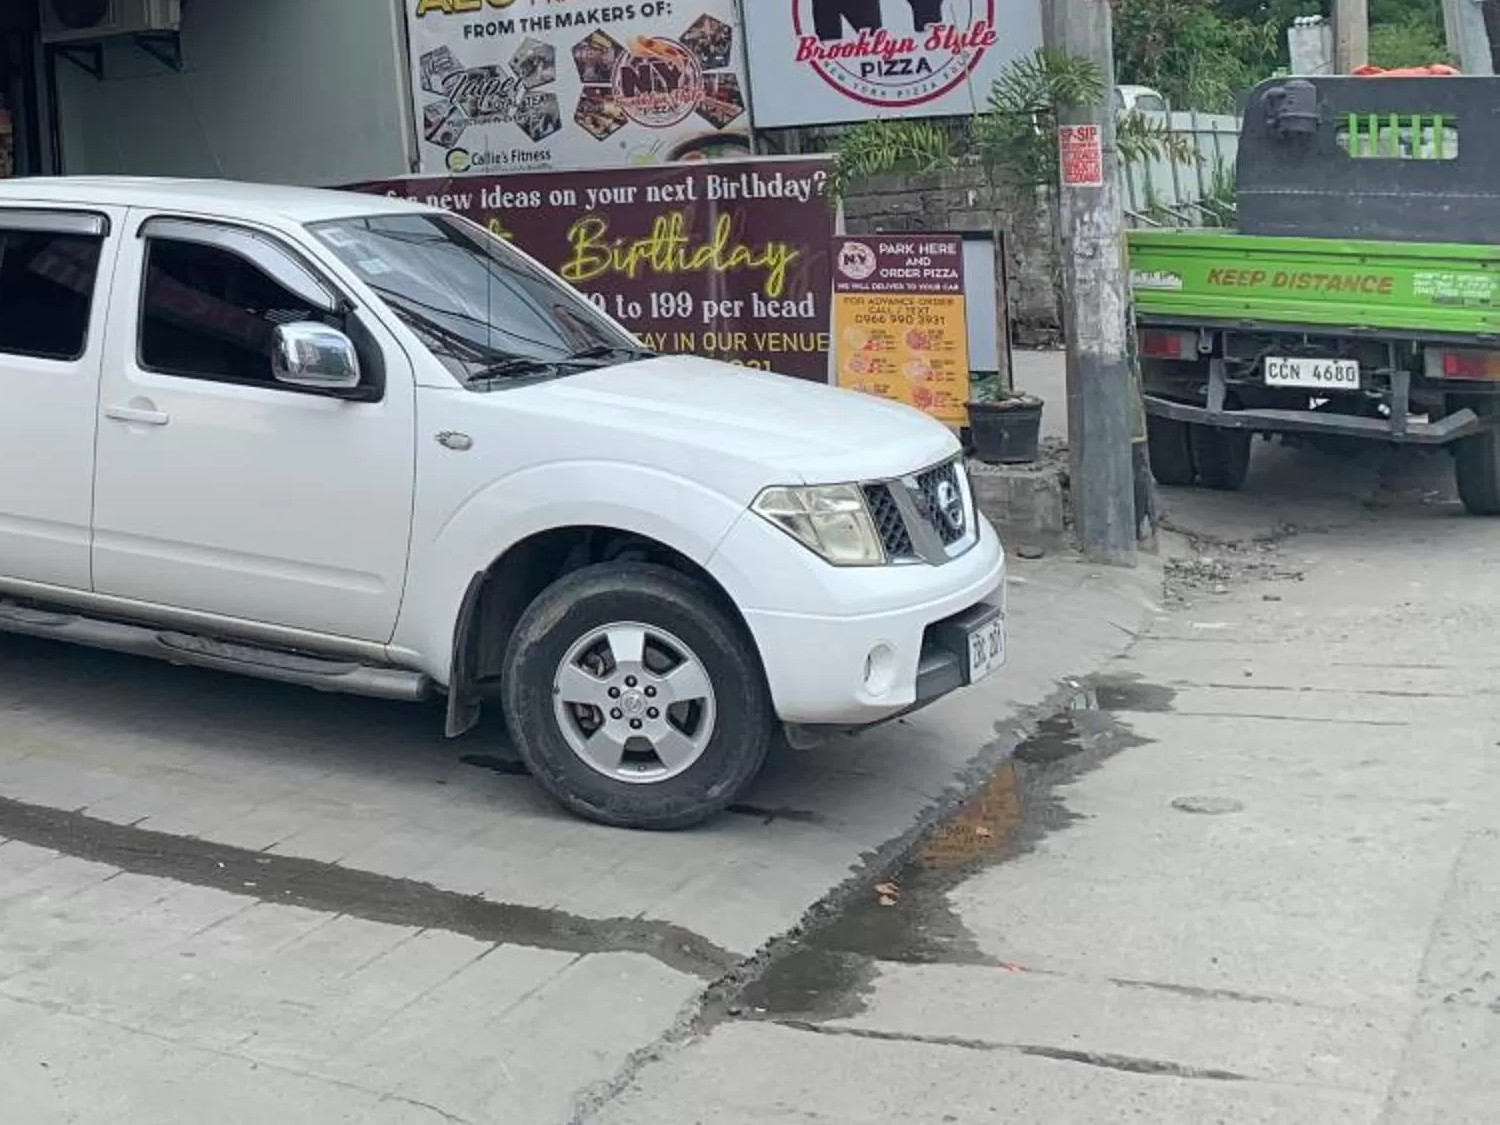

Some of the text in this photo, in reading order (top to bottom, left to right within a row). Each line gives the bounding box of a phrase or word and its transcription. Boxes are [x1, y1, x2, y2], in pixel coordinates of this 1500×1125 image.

[463, 0, 672, 40] FROM THE MAKERS OF:
[795, 20, 998, 63] Brooklyn Style
[860, 57, 933, 78] PIZZA
[620, 61, 682, 98] NY
[511, 148, 551, 163] Fitness
[425, 192, 473, 211] new
[481, 184, 542, 209] ideas
[549, 186, 578, 208] on
[586, 183, 637, 211] your
[646, 176, 695, 203] next
[706, 170, 827, 208] Birthday?
[560, 212, 799, 295] Birthday
[879, 242, 915, 255] PARK
[919, 242, 957, 255] HERE
[905, 256, 931, 266] AND
[880, 268, 959, 279] ORDER PIZZA
[1206, 267, 1267, 288] KEEP
[1271, 271, 1396, 296] DISTANCE
[906, 282, 917, 290] TO
[616, 293, 642, 319] to
[650, 290, 693, 318] 199
[702, 296, 744, 324] per
[752, 292, 816, 318] head
[867, 297, 914, 306] ADVANCE
[867, 306, 892, 314] CALL
[905, 306, 930, 315] TEXT
[890, 314, 914, 324] 990
[632, 331, 830, 353] AY IN OUR VENUE
[1268, 362, 1301, 381] CCN
